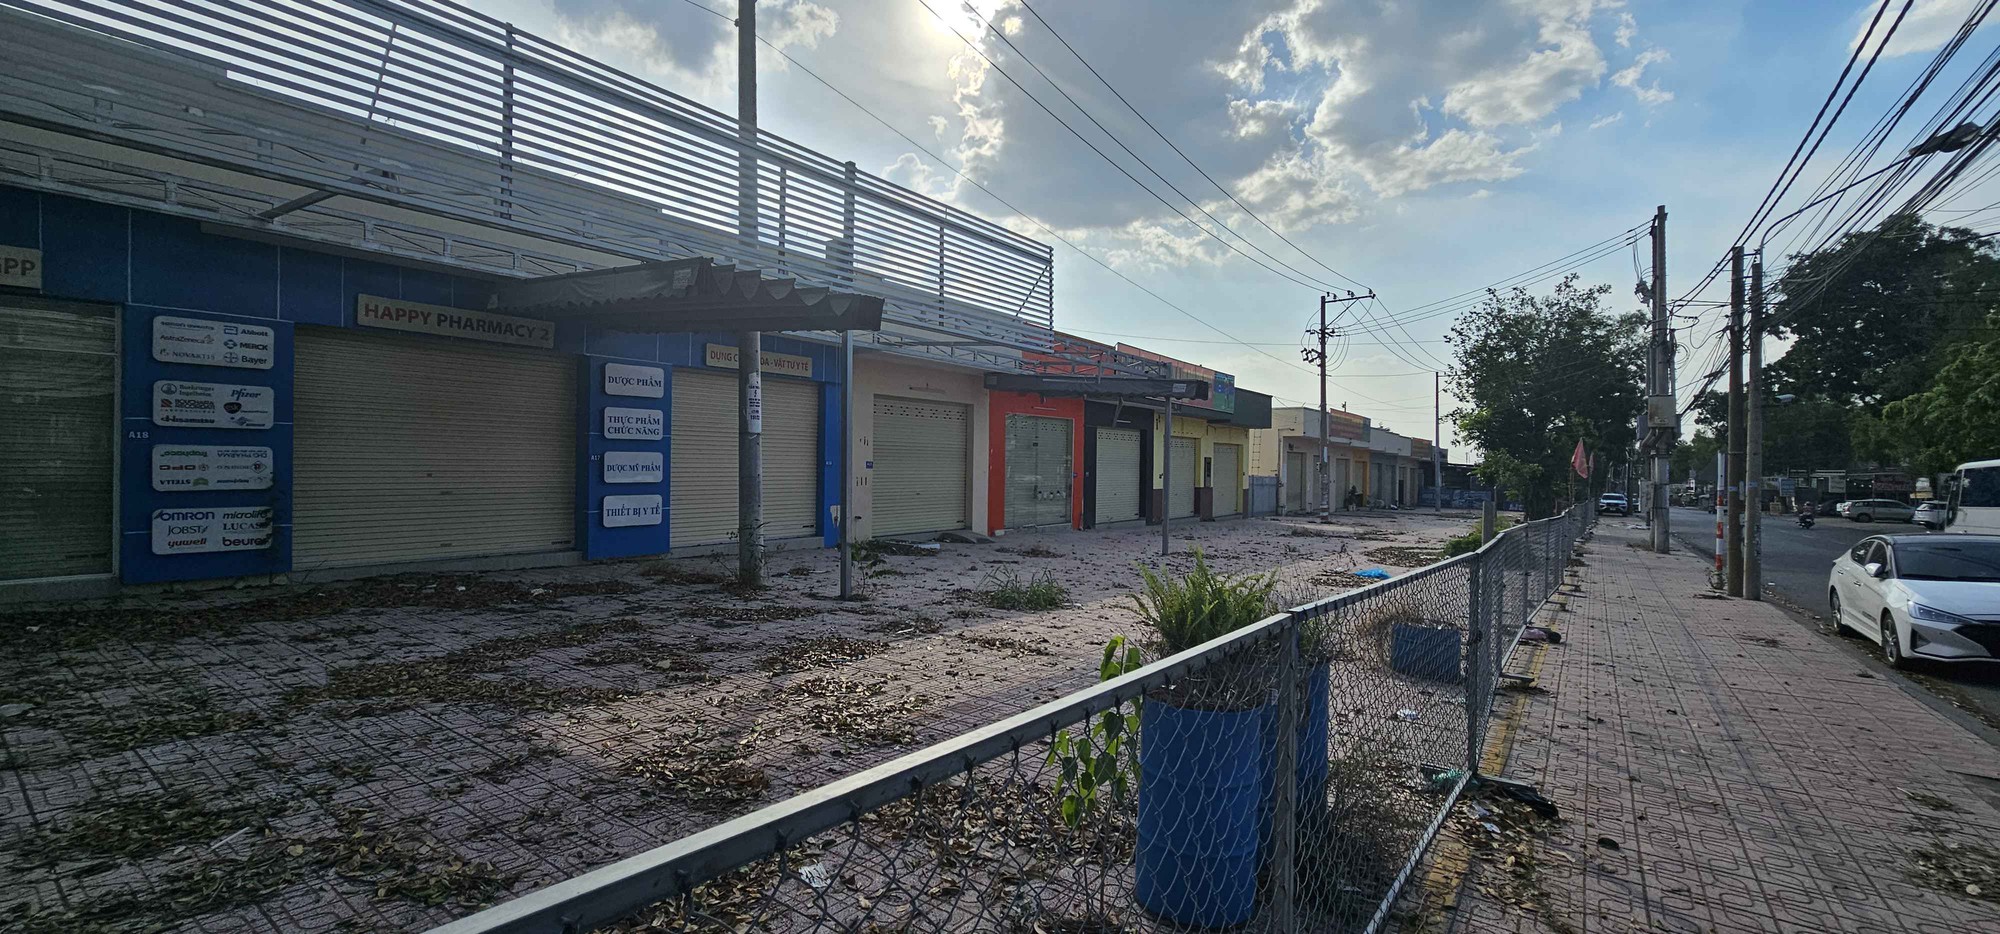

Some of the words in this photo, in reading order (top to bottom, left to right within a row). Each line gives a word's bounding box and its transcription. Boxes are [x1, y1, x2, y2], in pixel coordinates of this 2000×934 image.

[0, 257, 36, 276] PP
[364, 302, 432, 325] HAPPY
[436, 313, 538, 339] PHARMACY
[540, 329, 550, 341] 2
[240, 328, 269, 337] Abbott
[160, 334, 206, 344] AstraZeneca
[240, 342, 268, 351] MERCK
[241, 355, 267, 365] Bayer
[710, 350, 732, 363] DỤNG
[608, 375, 635, 386] DƯỢC
[636, 376, 662, 387] PHẨM
[231, 388, 261, 401] Pfizer
[608, 415, 634, 425] THỰC
[635, 414, 660, 425] PHẨM
[128, 431, 149, 439] A18
[607, 425, 634, 434] CHỨC
[635, 426, 660, 435] NĂNG
[606, 463, 628, 473] DƯỢC
[606, 503, 631, 517] THIẾT
[632, 507, 641, 517] BỊ
[642, 507, 649, 515] Y
[650, 502, 660, 515] TẾ
[167, 525, 203, 536] JOBST
[168, 538, 207, 549] yuwell
